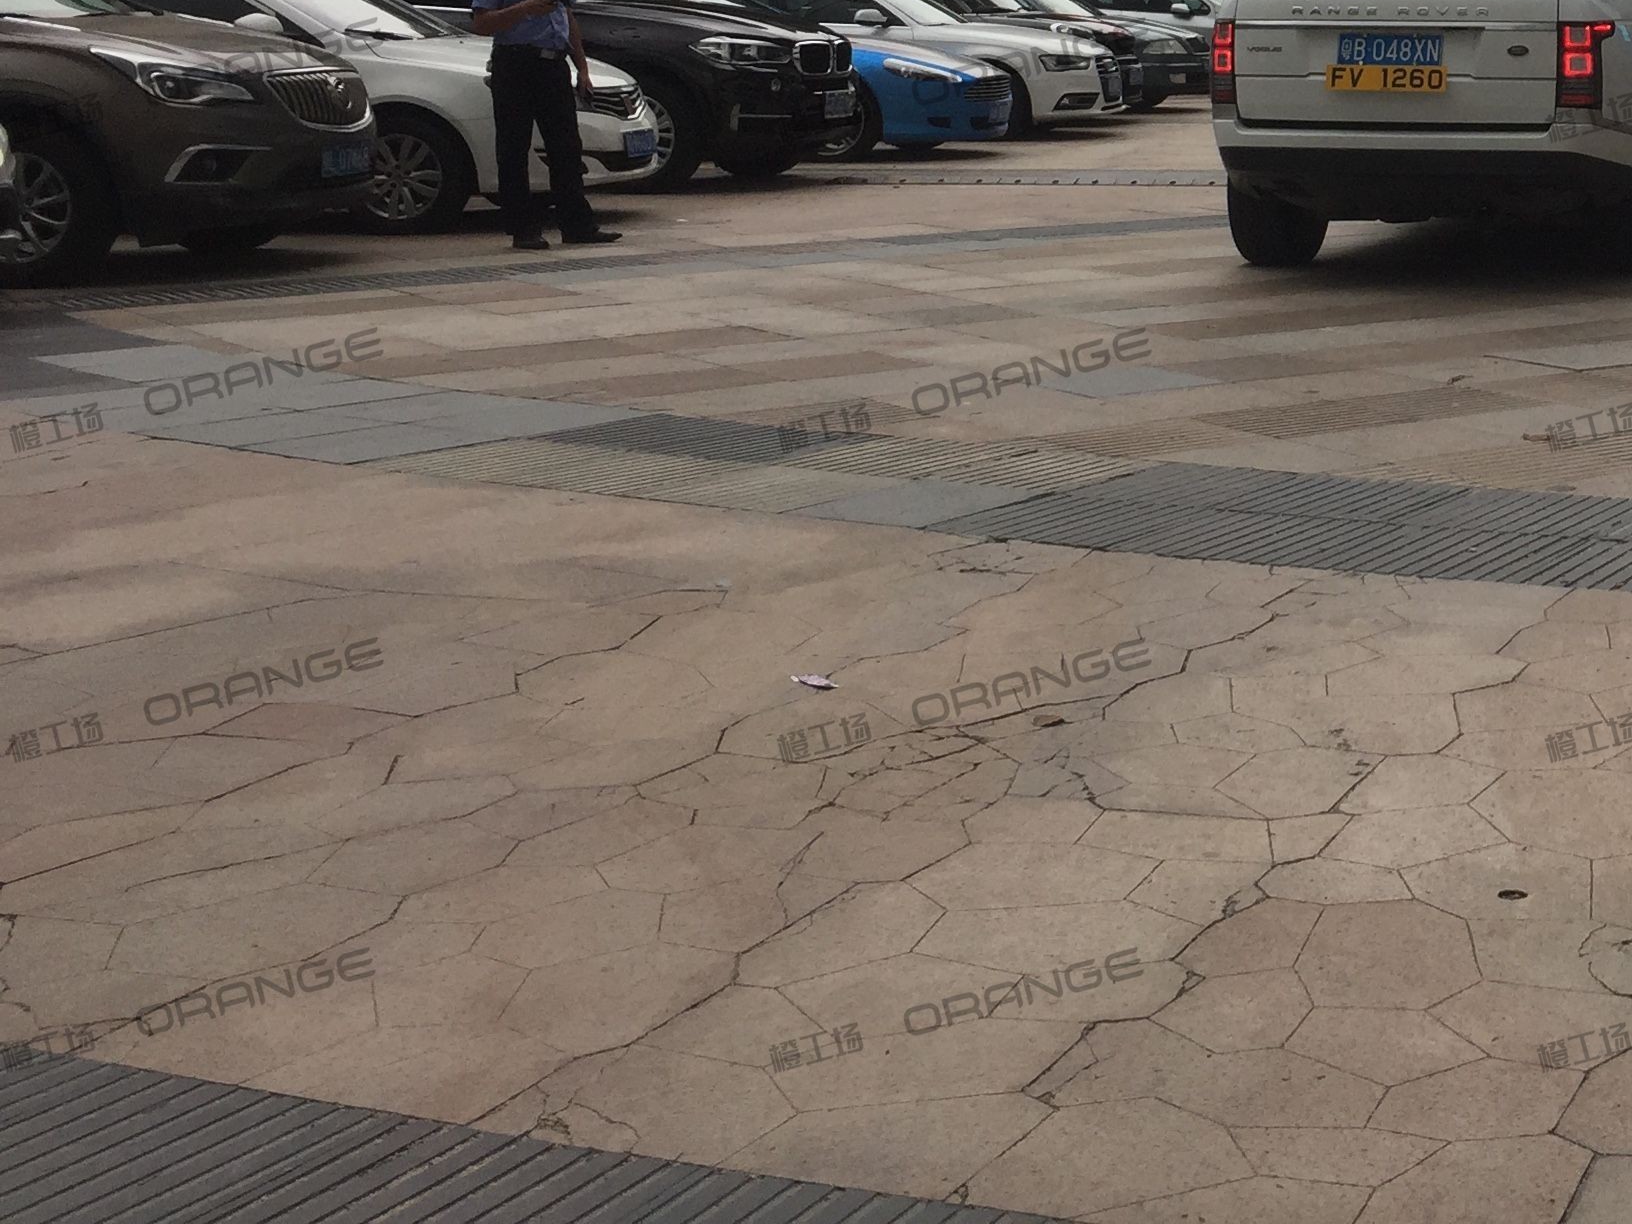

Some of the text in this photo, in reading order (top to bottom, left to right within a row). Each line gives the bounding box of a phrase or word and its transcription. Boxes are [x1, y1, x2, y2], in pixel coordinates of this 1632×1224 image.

[1291, 6, 1490, 17] RANGE ROVER
[1330, 67, 1443, 90] FV 1260
